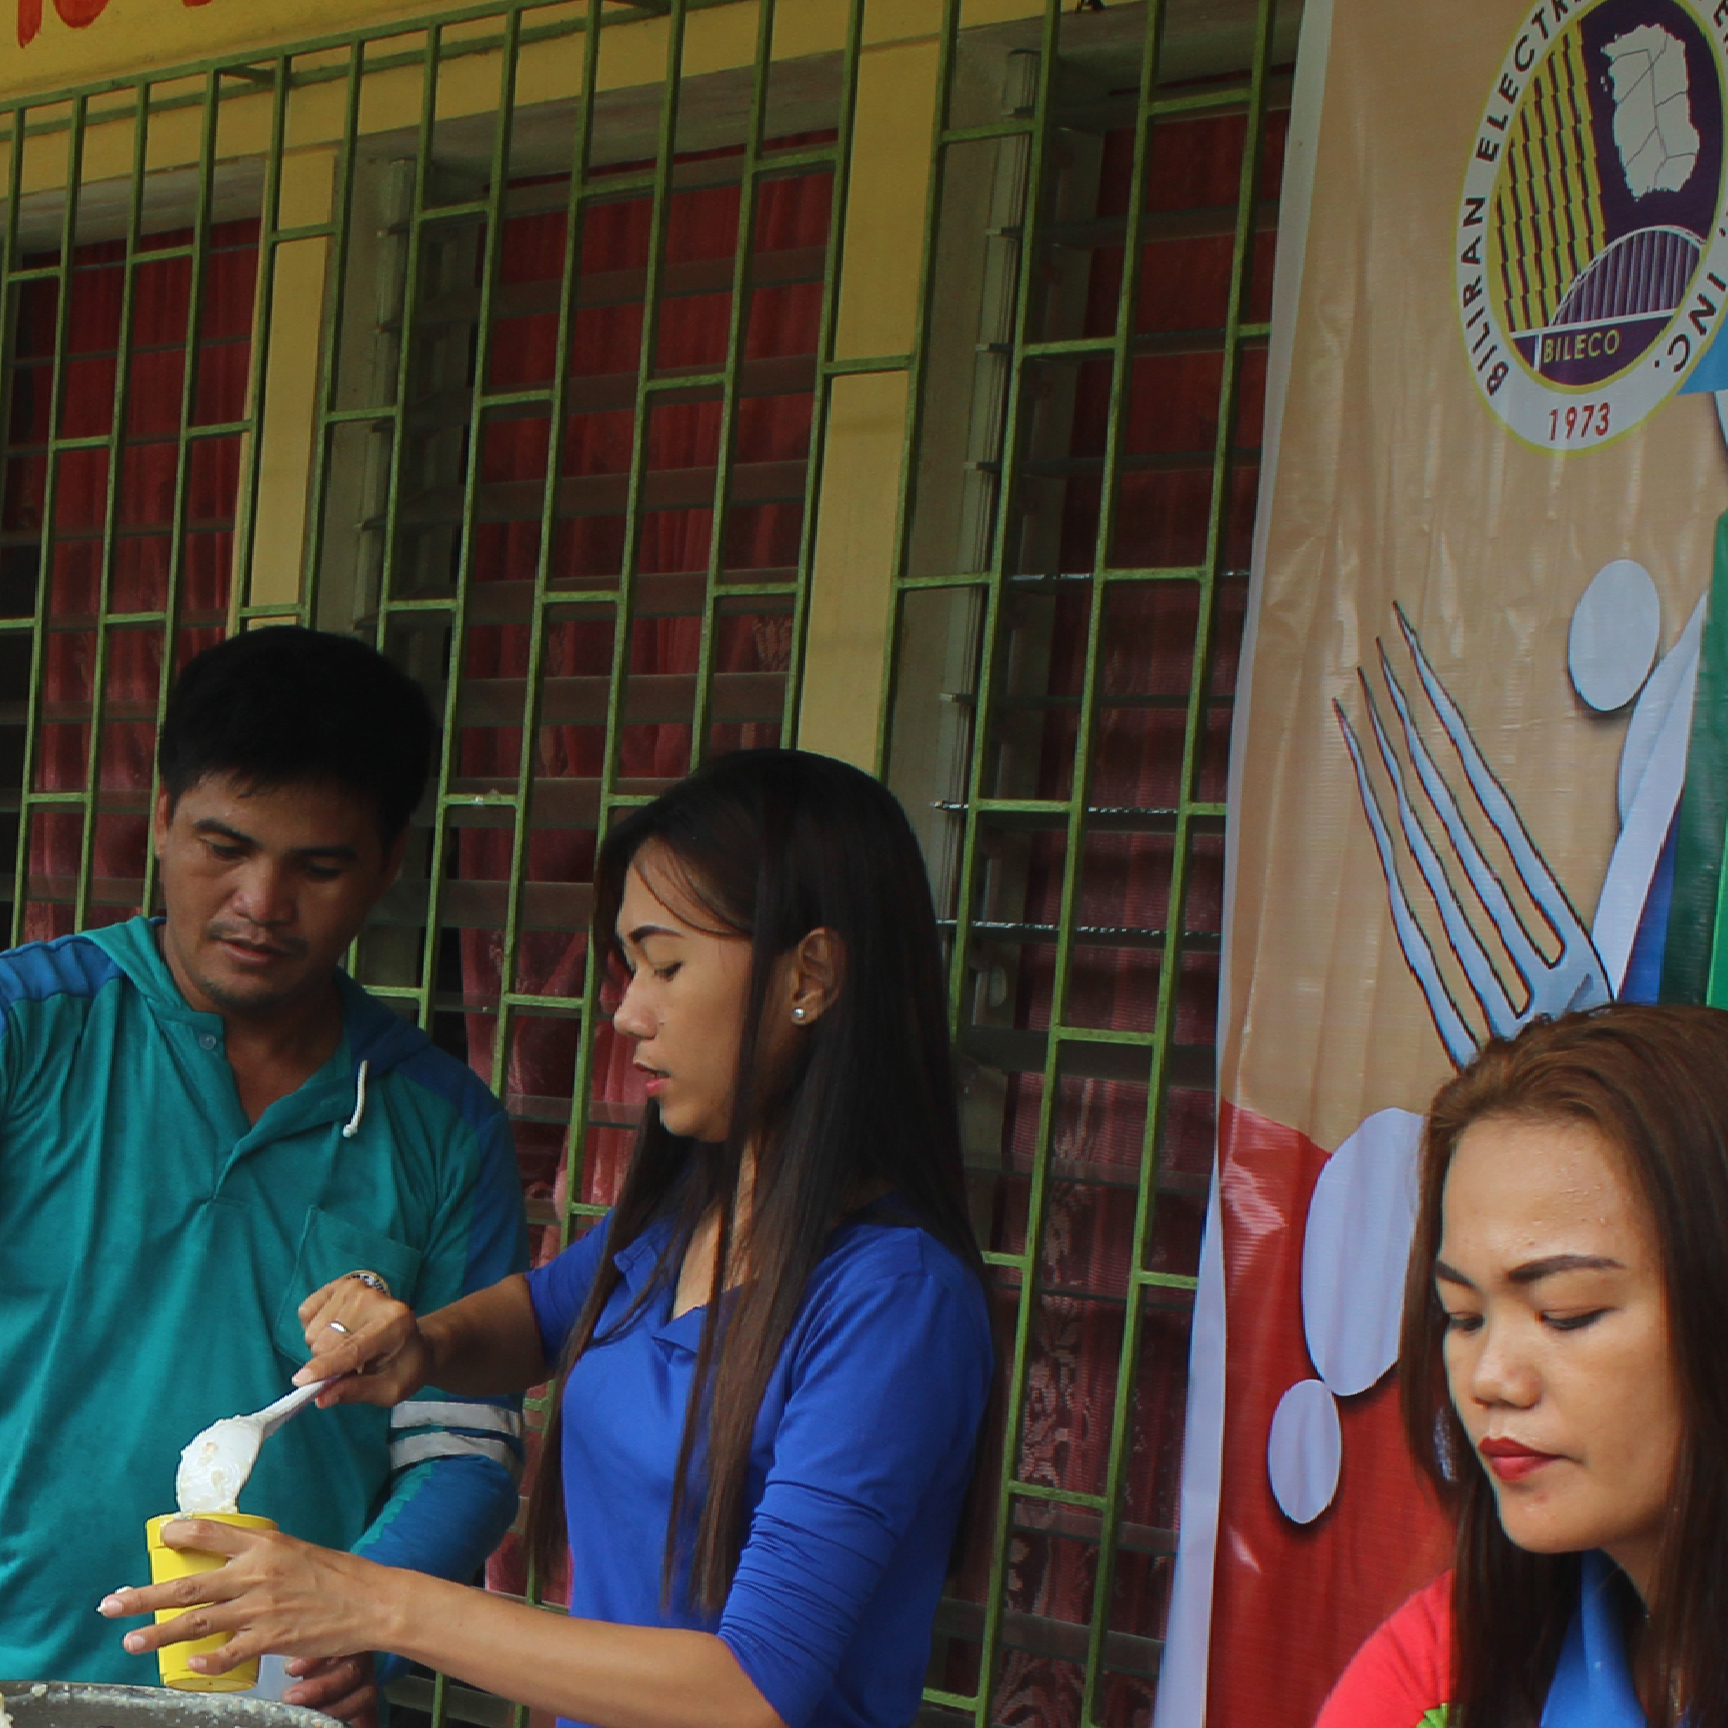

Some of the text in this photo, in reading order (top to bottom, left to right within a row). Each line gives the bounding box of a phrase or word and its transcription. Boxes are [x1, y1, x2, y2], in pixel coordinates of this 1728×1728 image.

[1461, 197, 1509, 396] BILIRAN
[1653, 272, 1728, 374] INC.
[1544, 329, 1622, 364] BILECO
[1548, 402, 1611, 441] 1973
